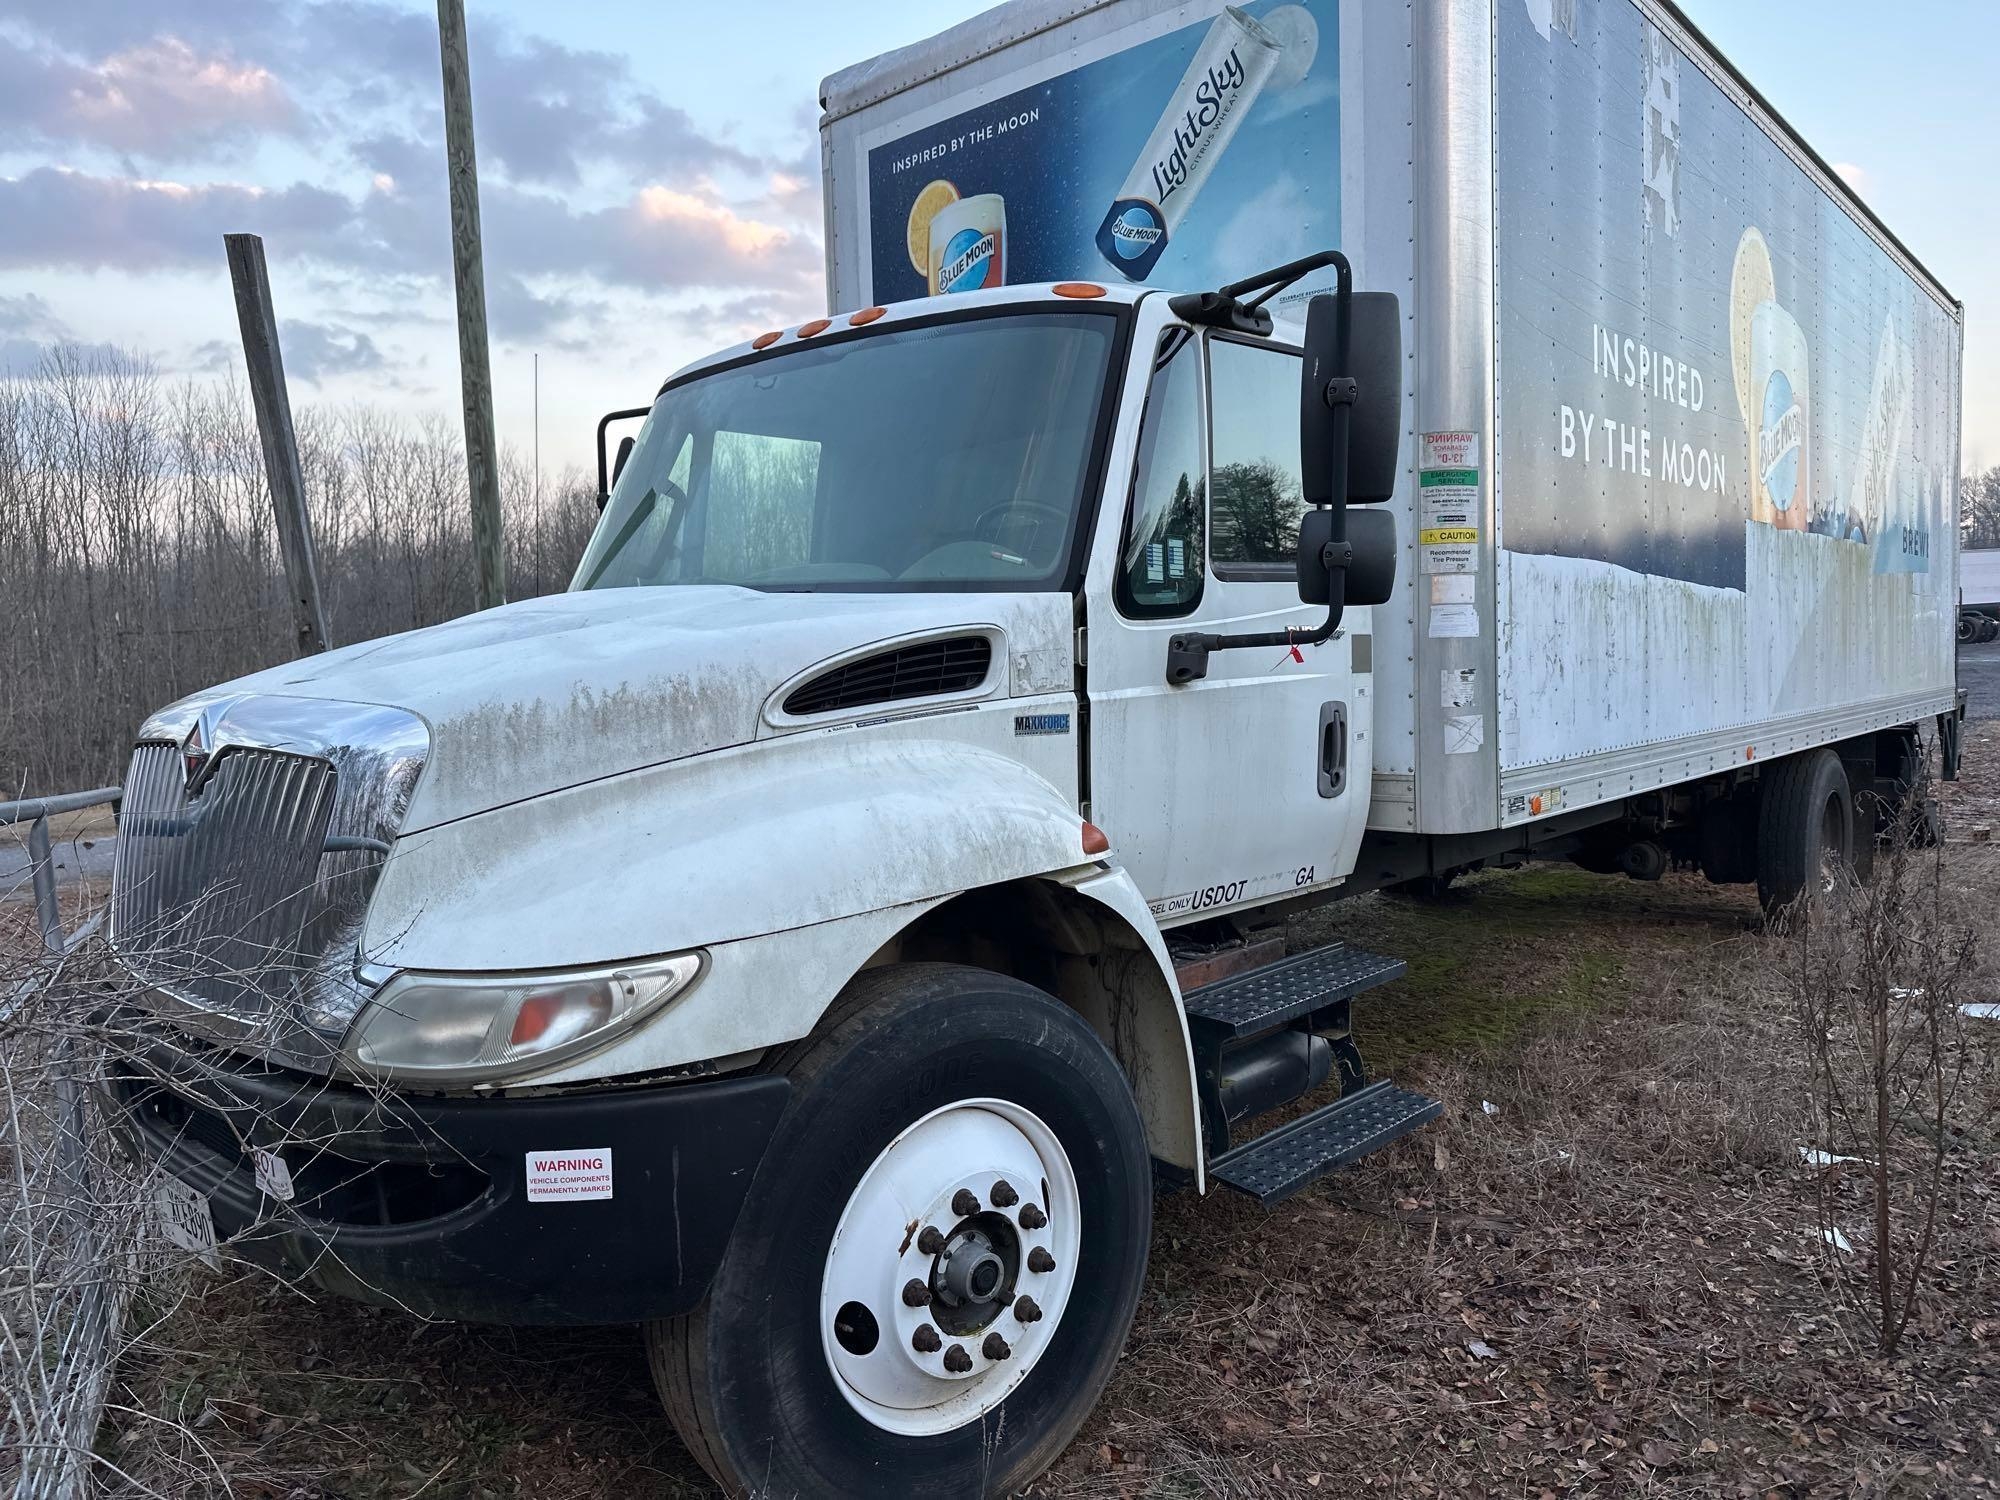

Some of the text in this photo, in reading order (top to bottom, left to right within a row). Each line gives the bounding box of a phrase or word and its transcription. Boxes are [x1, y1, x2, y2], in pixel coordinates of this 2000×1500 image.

[892, 108, 1039, 174] INSPIRED BY THE MOON
[1190, 93, 1239, 171] CITRUS WHEAT
[1112, 218, 1160, 241] BLUE MOON
[939, 237, 993, 291] BLUE MOON
[1593, 323, 1704, 412] INSPIRED
[1561, 404, 1726, 496] BY THE MOON
[1760, 427, 1780, 479] BLUE
[1440, 531, 1476, 540] CAUTION
[1014, 714, 1070, 731] MAXXFORCE
[1295, 865, 1315, 886] GA
[1149, 880, 1248, 915] SEL ONLY USDOT
[535, 1158, 603, 1172] WARNING
[529, 1175, 610, 1185] VEHICLE COMPONENTS
[529, 1185, 611, 1195] PERMANENTLY MARKED
